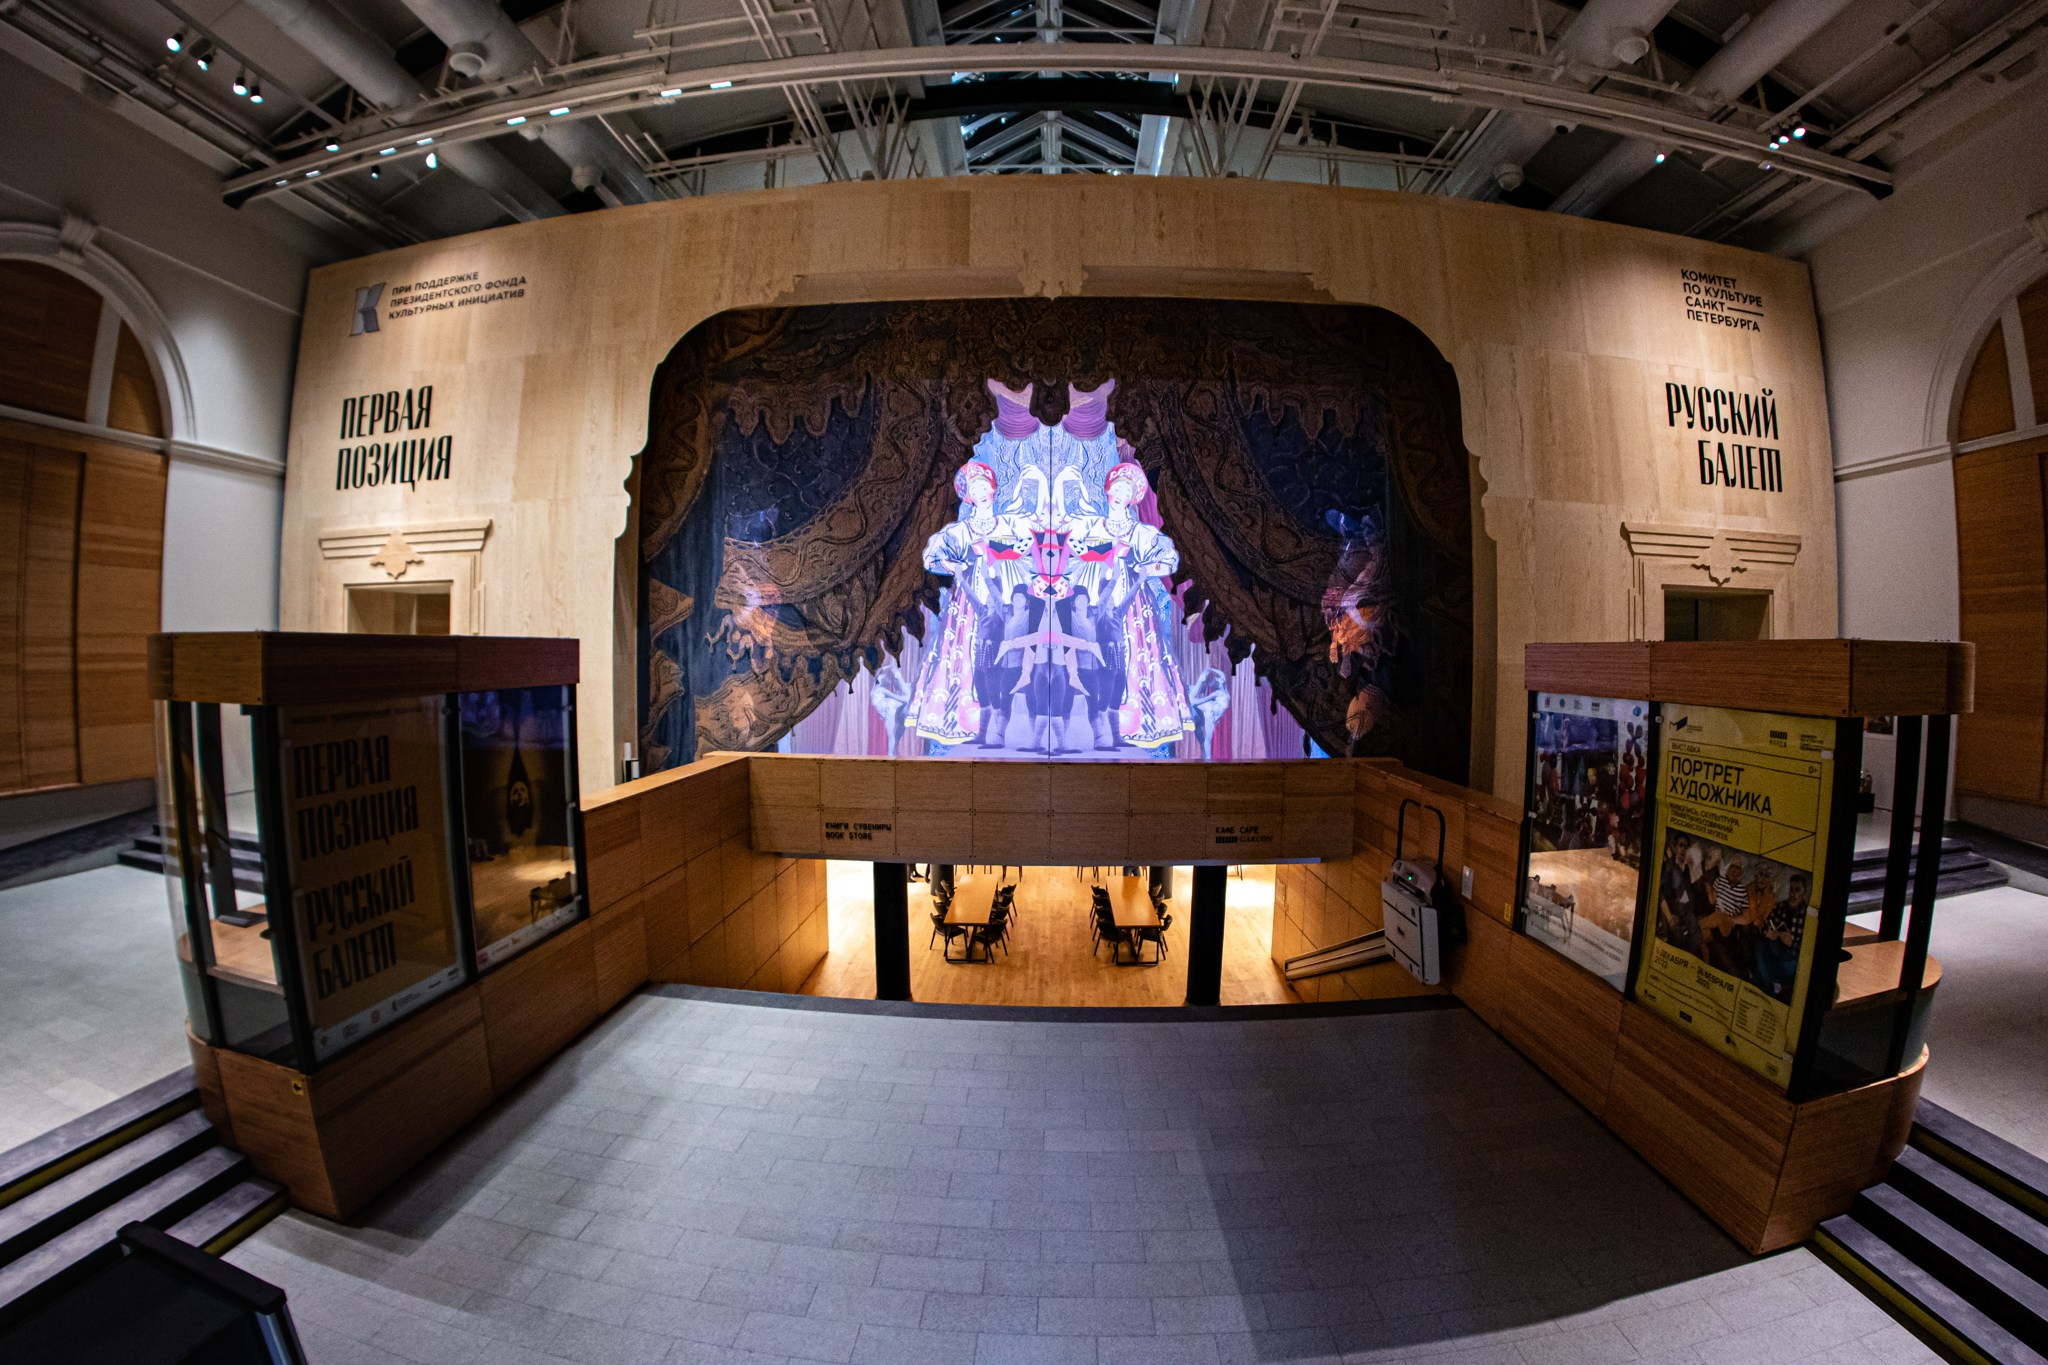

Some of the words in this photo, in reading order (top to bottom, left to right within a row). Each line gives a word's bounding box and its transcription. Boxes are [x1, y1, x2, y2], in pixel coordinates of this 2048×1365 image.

[390, 283, 482, 308] ПРЕЗИДЕНТСКОГО
[484, 275, 528, 290] ФОНДА
[391, 284, 412, 297] ПРИ
[414, 271, 480, 291] ПОДДЕРЖКЕ
[1681, 268, 1738, 290] КОМИТЕТ
[1683, 282, 1702, 296] ПО
[1704, 286, 1764, 308] КУЛЬТУРЕ
[388, 300, 455, 320] КУЛЬТУРНЫХ
[457, 288, 526, 307] ИНИЦИАТИВ
[1686, 309, 1761, 333] ПЕТЕРБУРГА
[339, 384, 434, 440] ПЕРВАЯ
[1665, 381, 1780, 441] РУССКИЙ
[335, 434, 453, 493] ПОЗИЦИЯ
[1697, 439, 1783, 493] БАЛЕТ
[293, 735, 391, 800] ПЕРВАЯ
[1671, 755, 1745, 787] ПОРТРЕТ
[1669, 775, 1772, 816] ХУДОЖНИКА
[297, 784, 419, 862] ПОЗИЦИЯ
[825, 822, 849, 830] КНИГИ
[853, 822, 892, 831] СУВЕНИРЫ
[825, 831, 845, 840] BOOK
[848, 831, 873, 841] STORE
[1240, 826, 1259, 834] CAFE
[304, 855, 416, 943] РУССКИЙ
[312, 921, 398, 1001] БАЛЕТ
